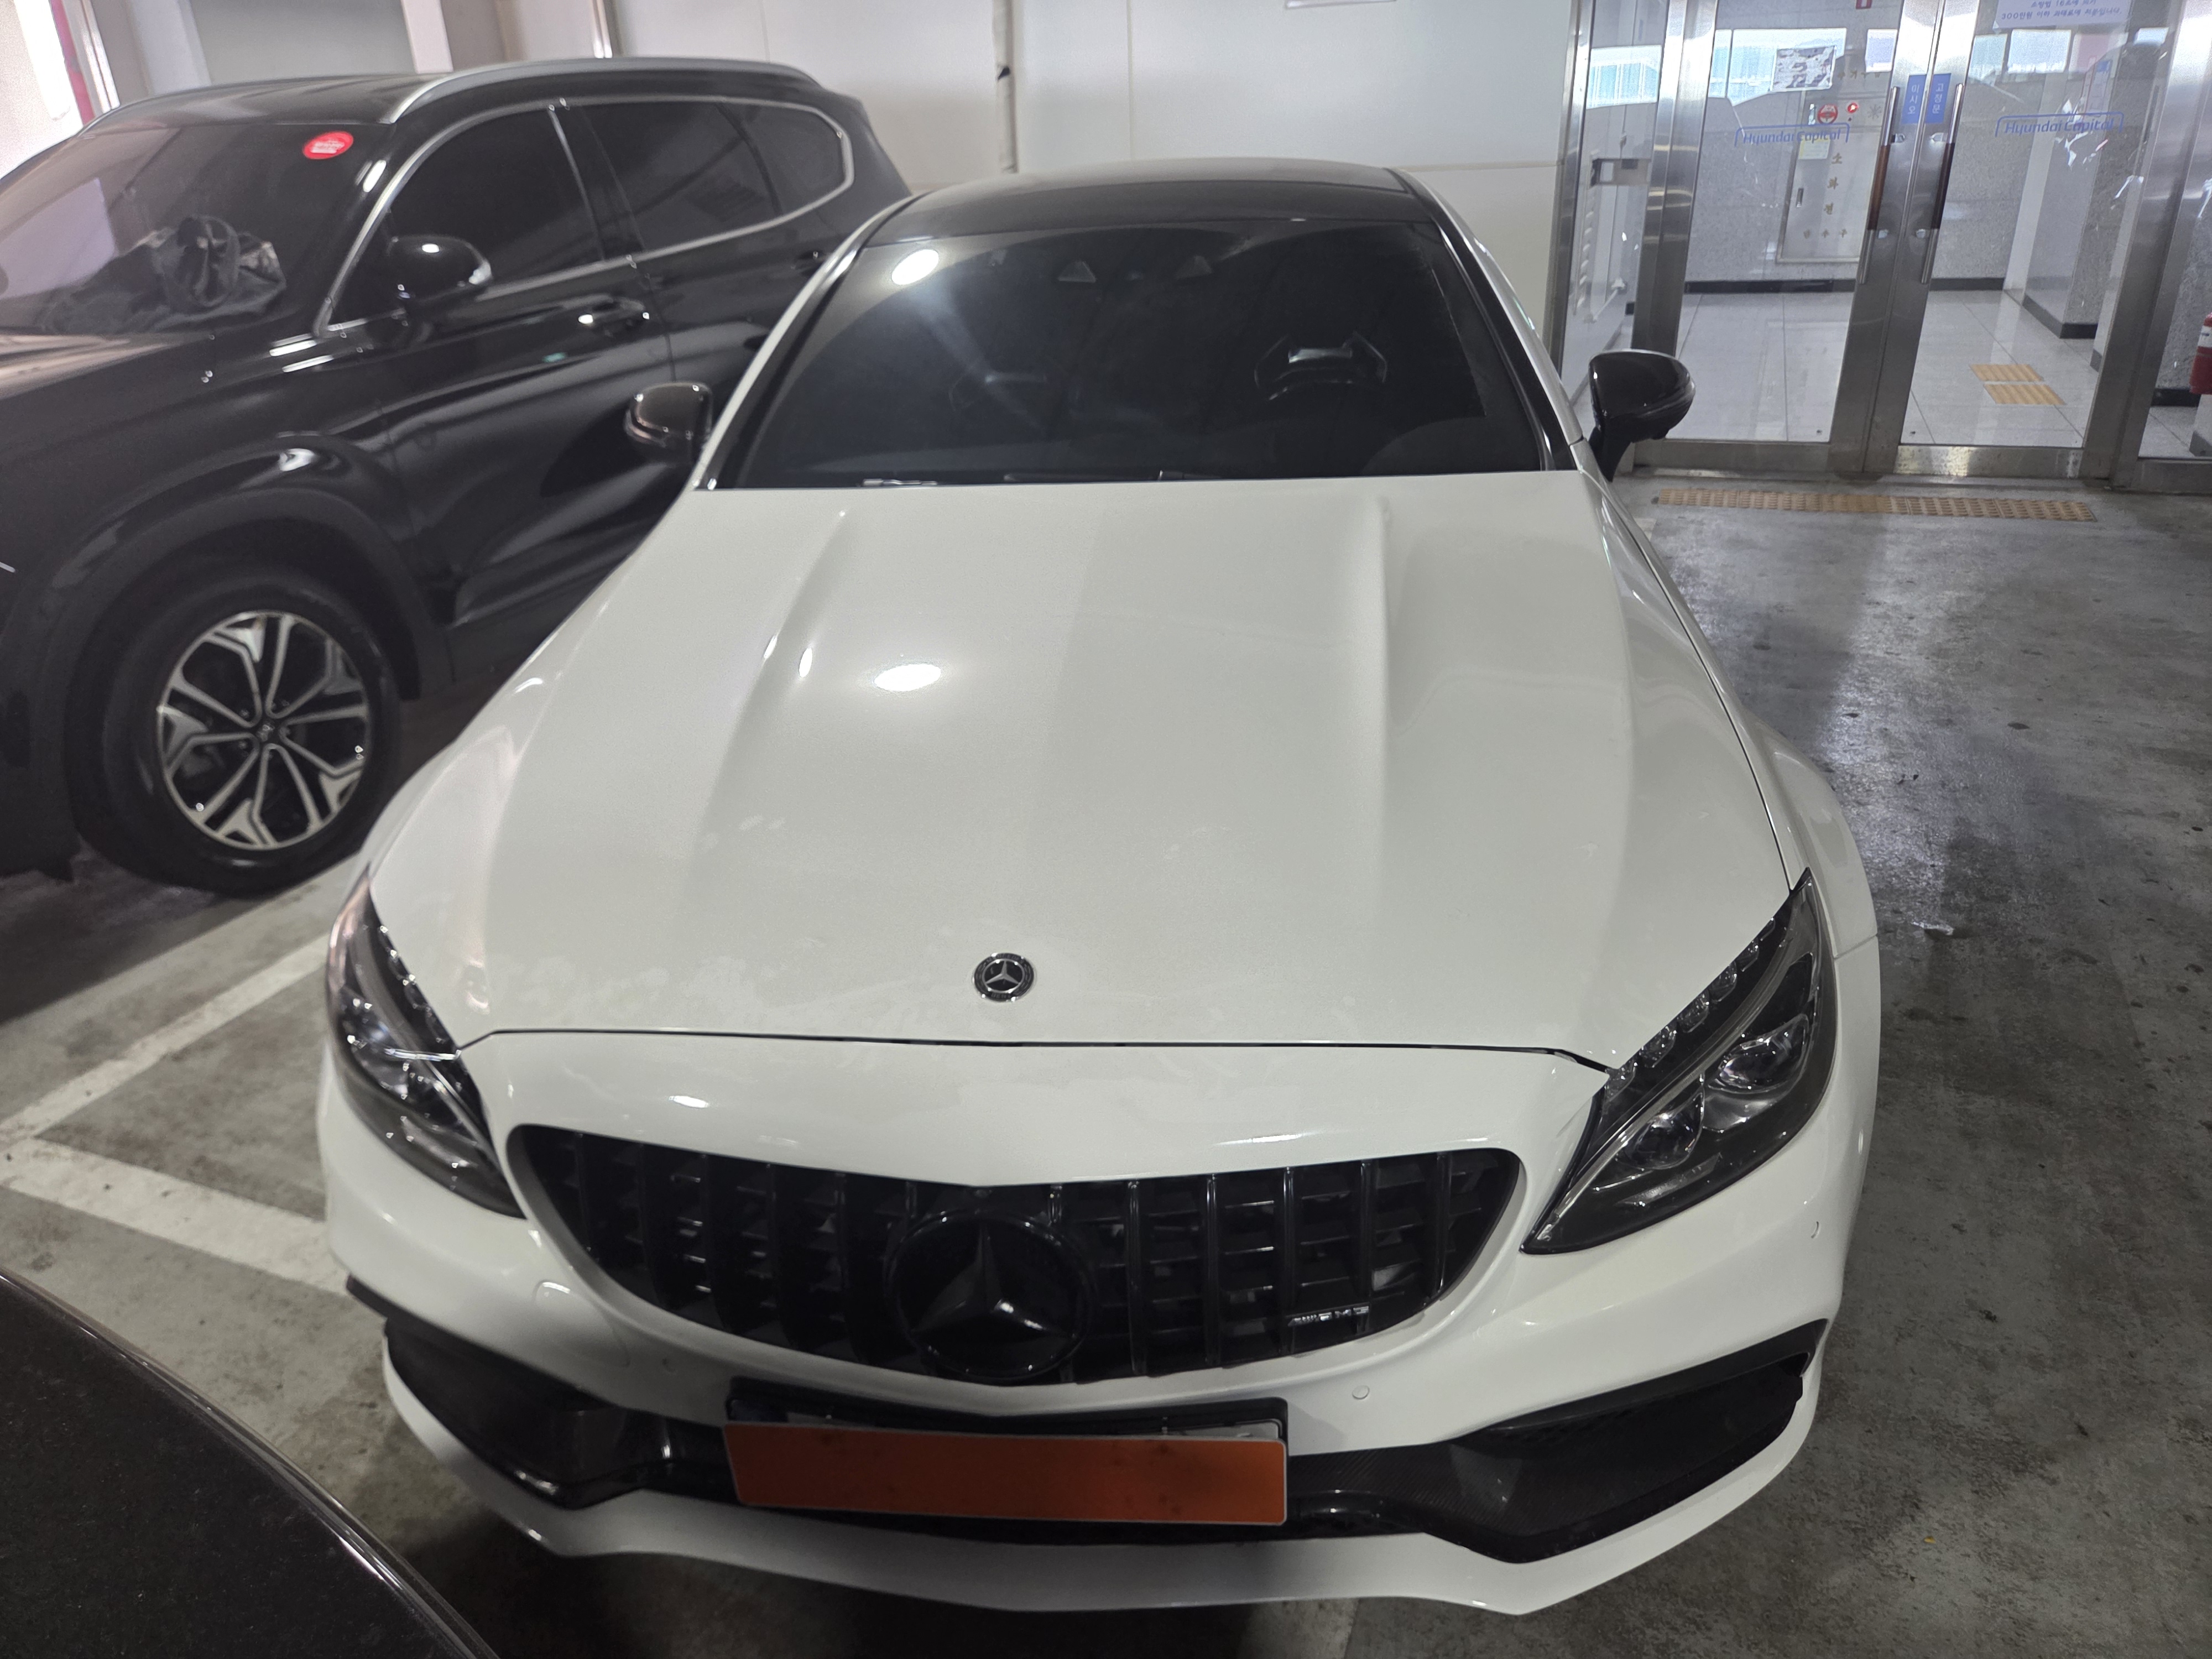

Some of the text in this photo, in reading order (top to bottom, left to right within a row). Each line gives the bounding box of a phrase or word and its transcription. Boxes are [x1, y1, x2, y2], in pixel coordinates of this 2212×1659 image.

[2001, 11, 2033, 20] 300만원
[1907, 84, 1920, 115] 미시오
[1932, 82, 1944, 114] 고정문
[2004, 118, 2115, 135] Hyundai Capital
[1743, 128, 1841, 145] Hyundai Capital
